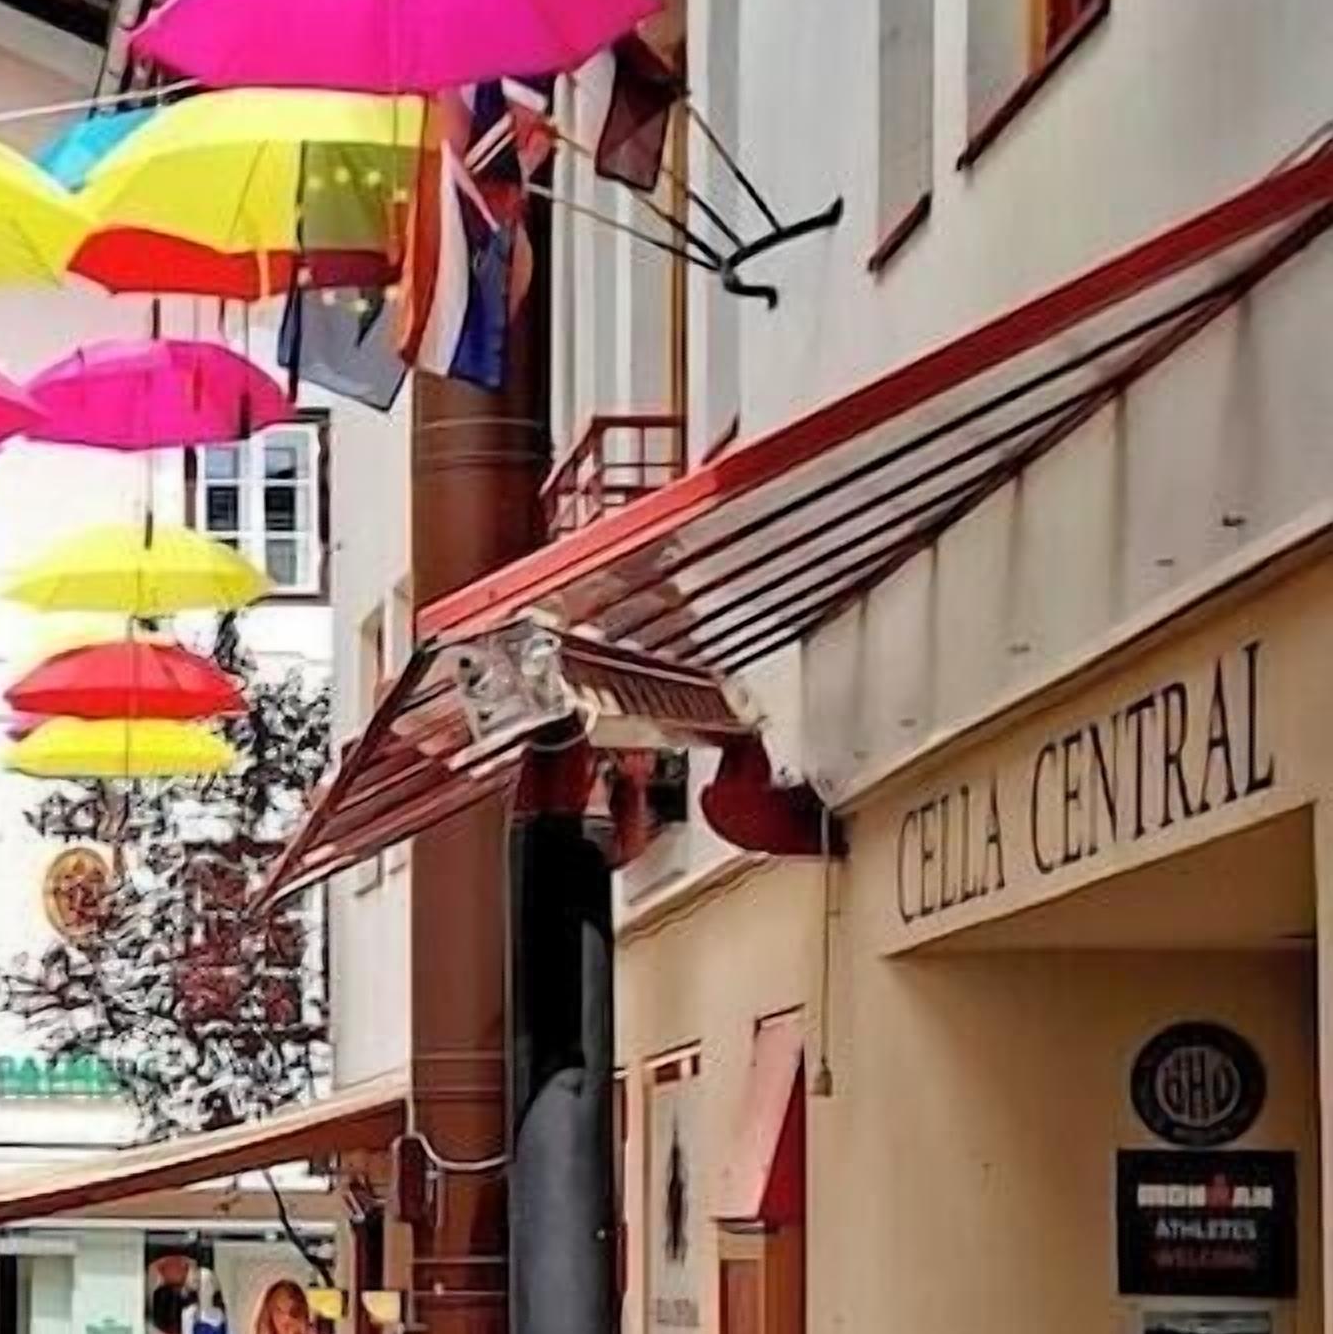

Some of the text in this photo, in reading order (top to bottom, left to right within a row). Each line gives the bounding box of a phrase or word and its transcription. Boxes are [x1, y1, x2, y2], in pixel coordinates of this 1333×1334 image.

[897, 640, 1275, 925] CELLA CENTRAL
[1156, 1219, 1257, 1240] ATHLETES
